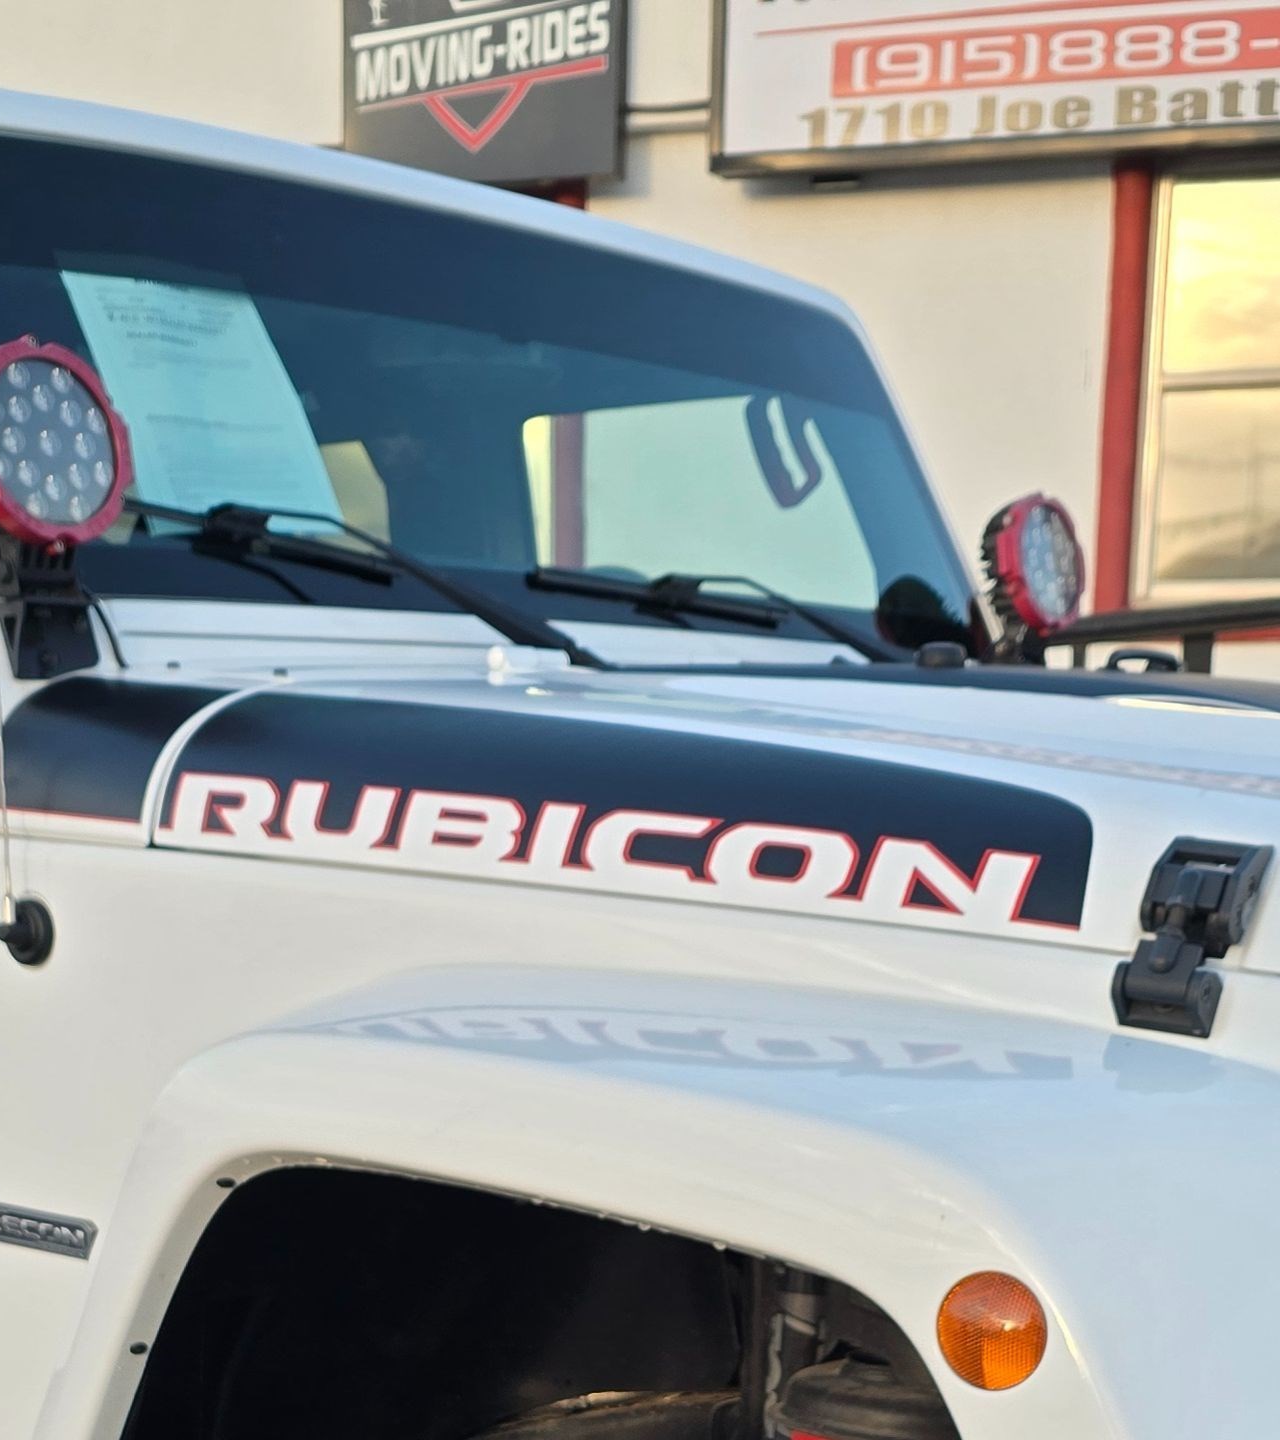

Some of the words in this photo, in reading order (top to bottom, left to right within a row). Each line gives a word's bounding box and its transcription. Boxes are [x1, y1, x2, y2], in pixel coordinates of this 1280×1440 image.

[355, 5, 611, 103] MOVING-RIDES
[800, 100, 950, 149] 1710
[974, 94, 1092, 136] Joe
[160, 772, 1042, 926] RUBICON
